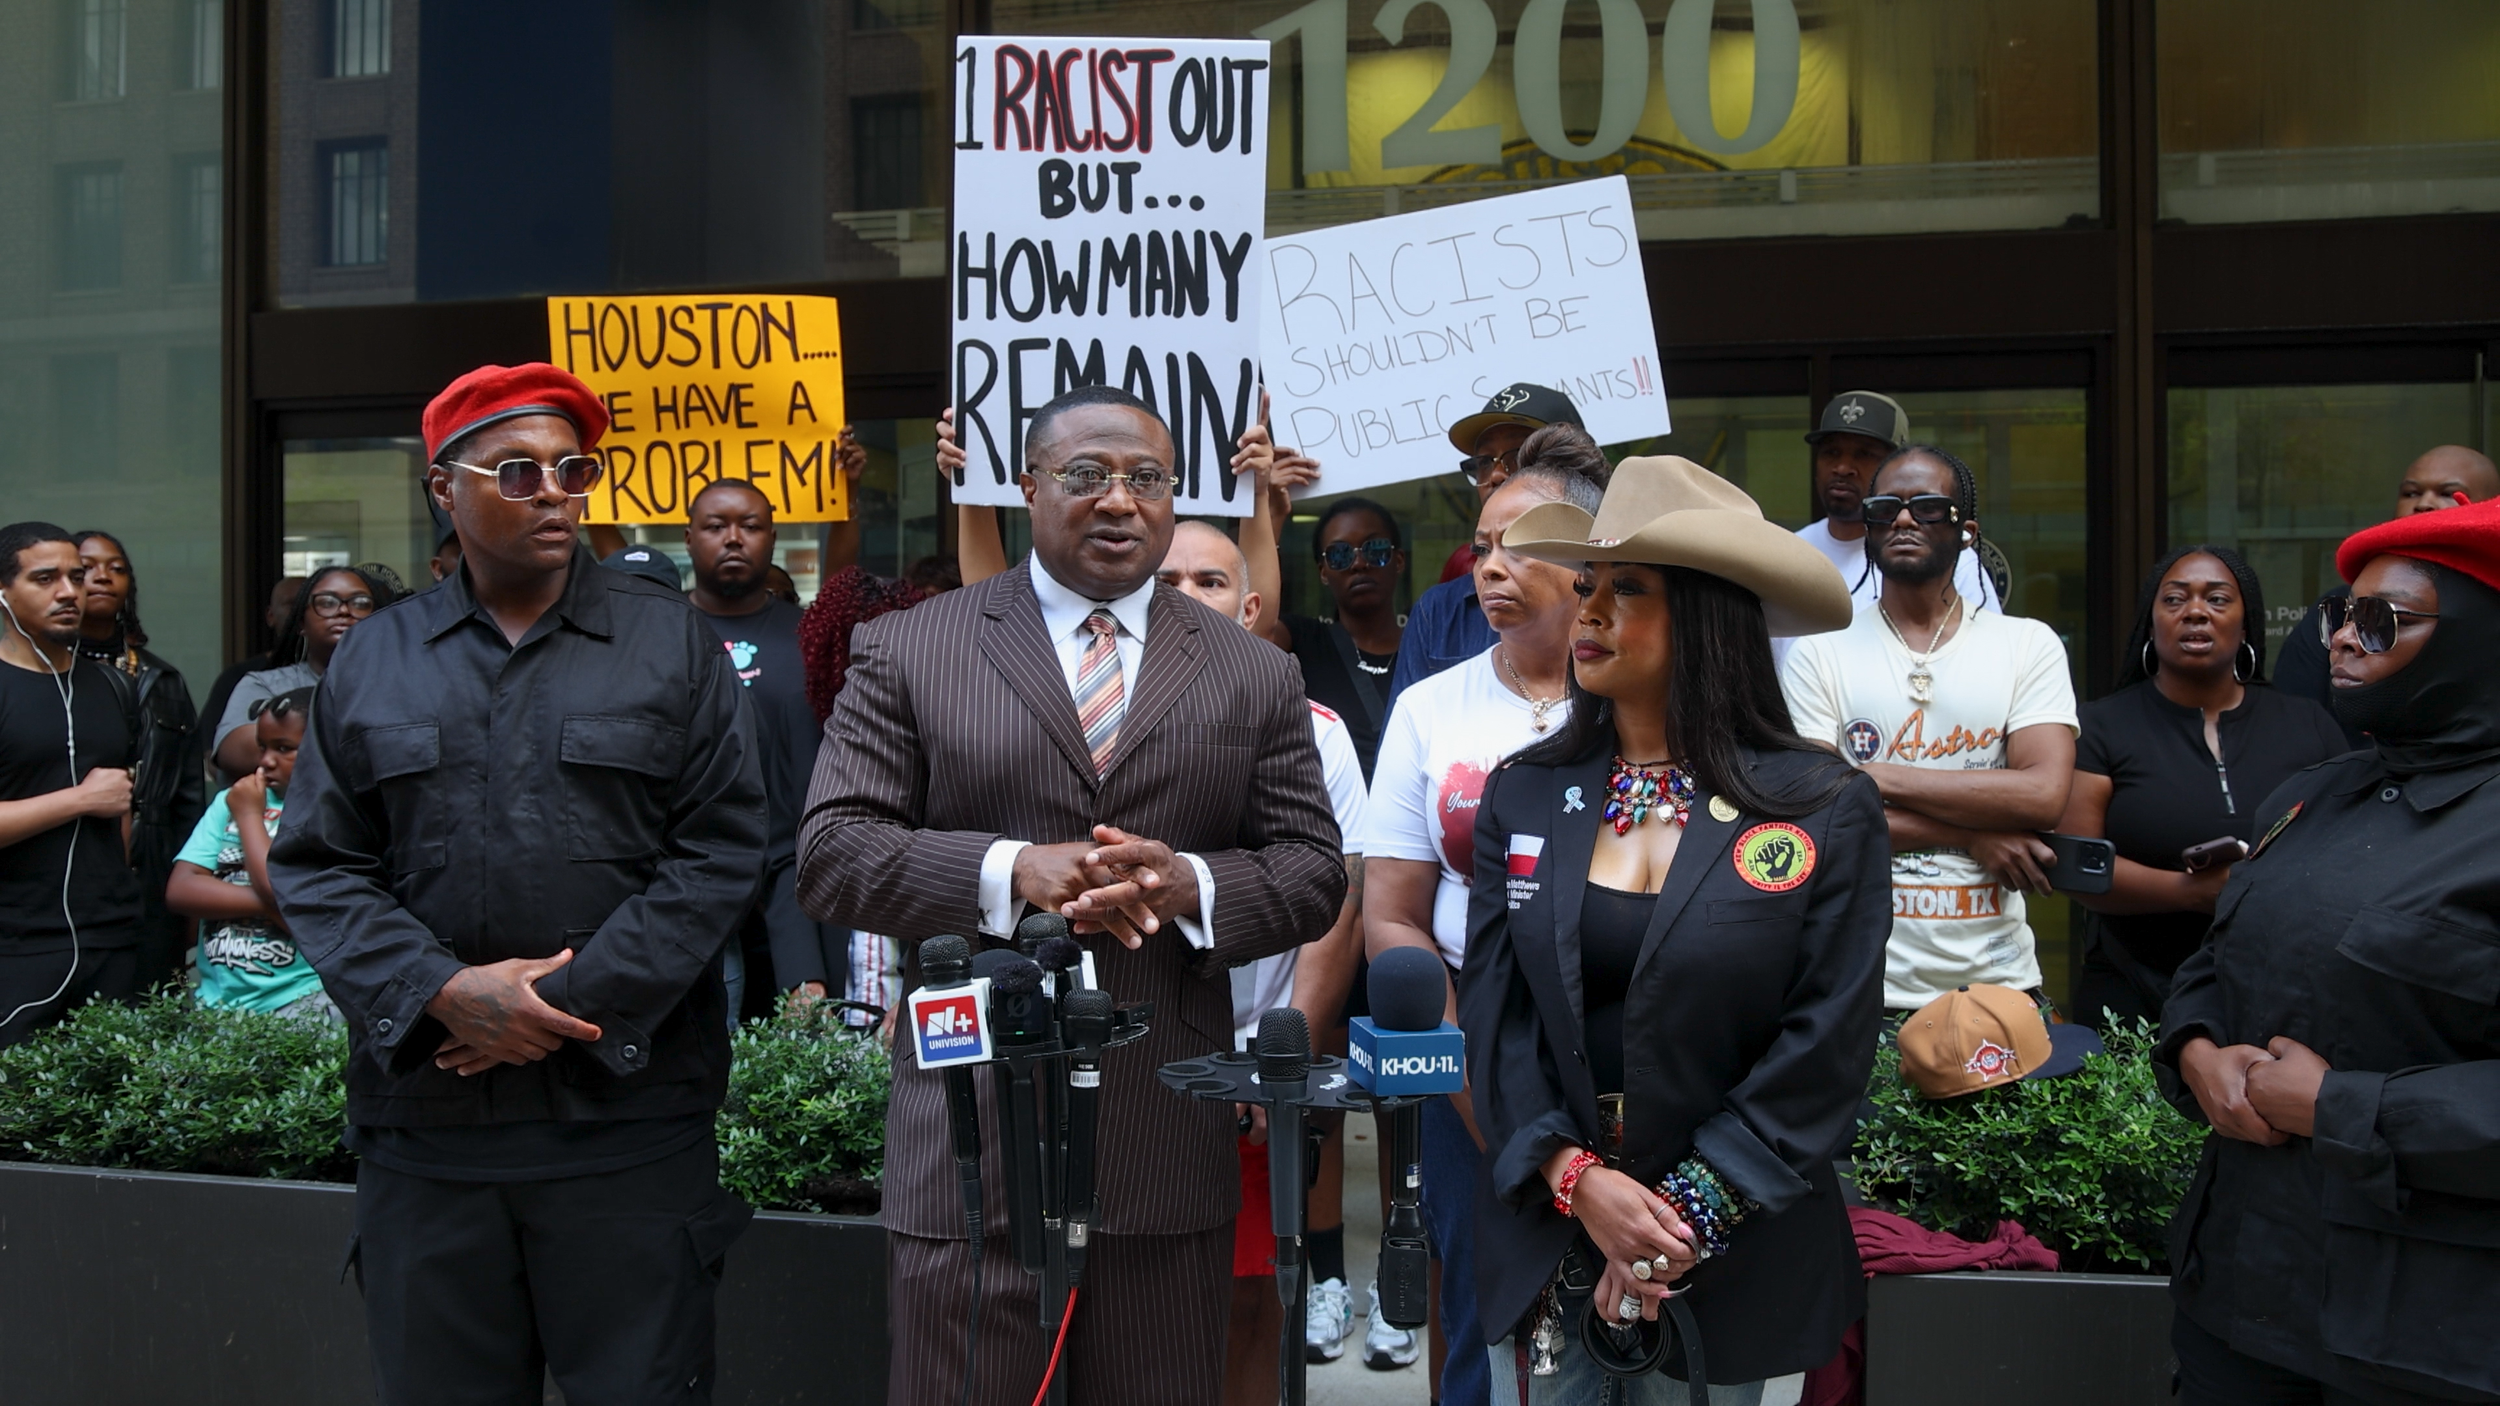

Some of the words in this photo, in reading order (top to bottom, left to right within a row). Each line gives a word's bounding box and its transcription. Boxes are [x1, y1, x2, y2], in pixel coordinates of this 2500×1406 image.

[955, 46, 983, 150] 1
[993, 43, 1175, 153] RACIST
[1168, 56, 1268, 154] OUT
[1249, 0, 1800, 174] 1200
[1038, 158, 1205, 219] BUT...
[957, 231, 1091, 322] HOW
[1097, 229, 1252, 322] MANY
[1270, 206, 1627, 344] RACISTS
[1285, 314, 1496, 397] SHOULDN'T
[1525, 296, 1589, 338] BE
[599, 391, 635, 432] E
[653, 383, 758, 432] HAVE
[787, 380, 817, 425] A
[1853, 731, 1872, 752] H
[1886, 708, 2006, 761] Astro
[1447, 790, 1481, 813] Your
[1968, 888, 1996, 914] TX
[928, 1035, 974, 1050] UNIVISION
